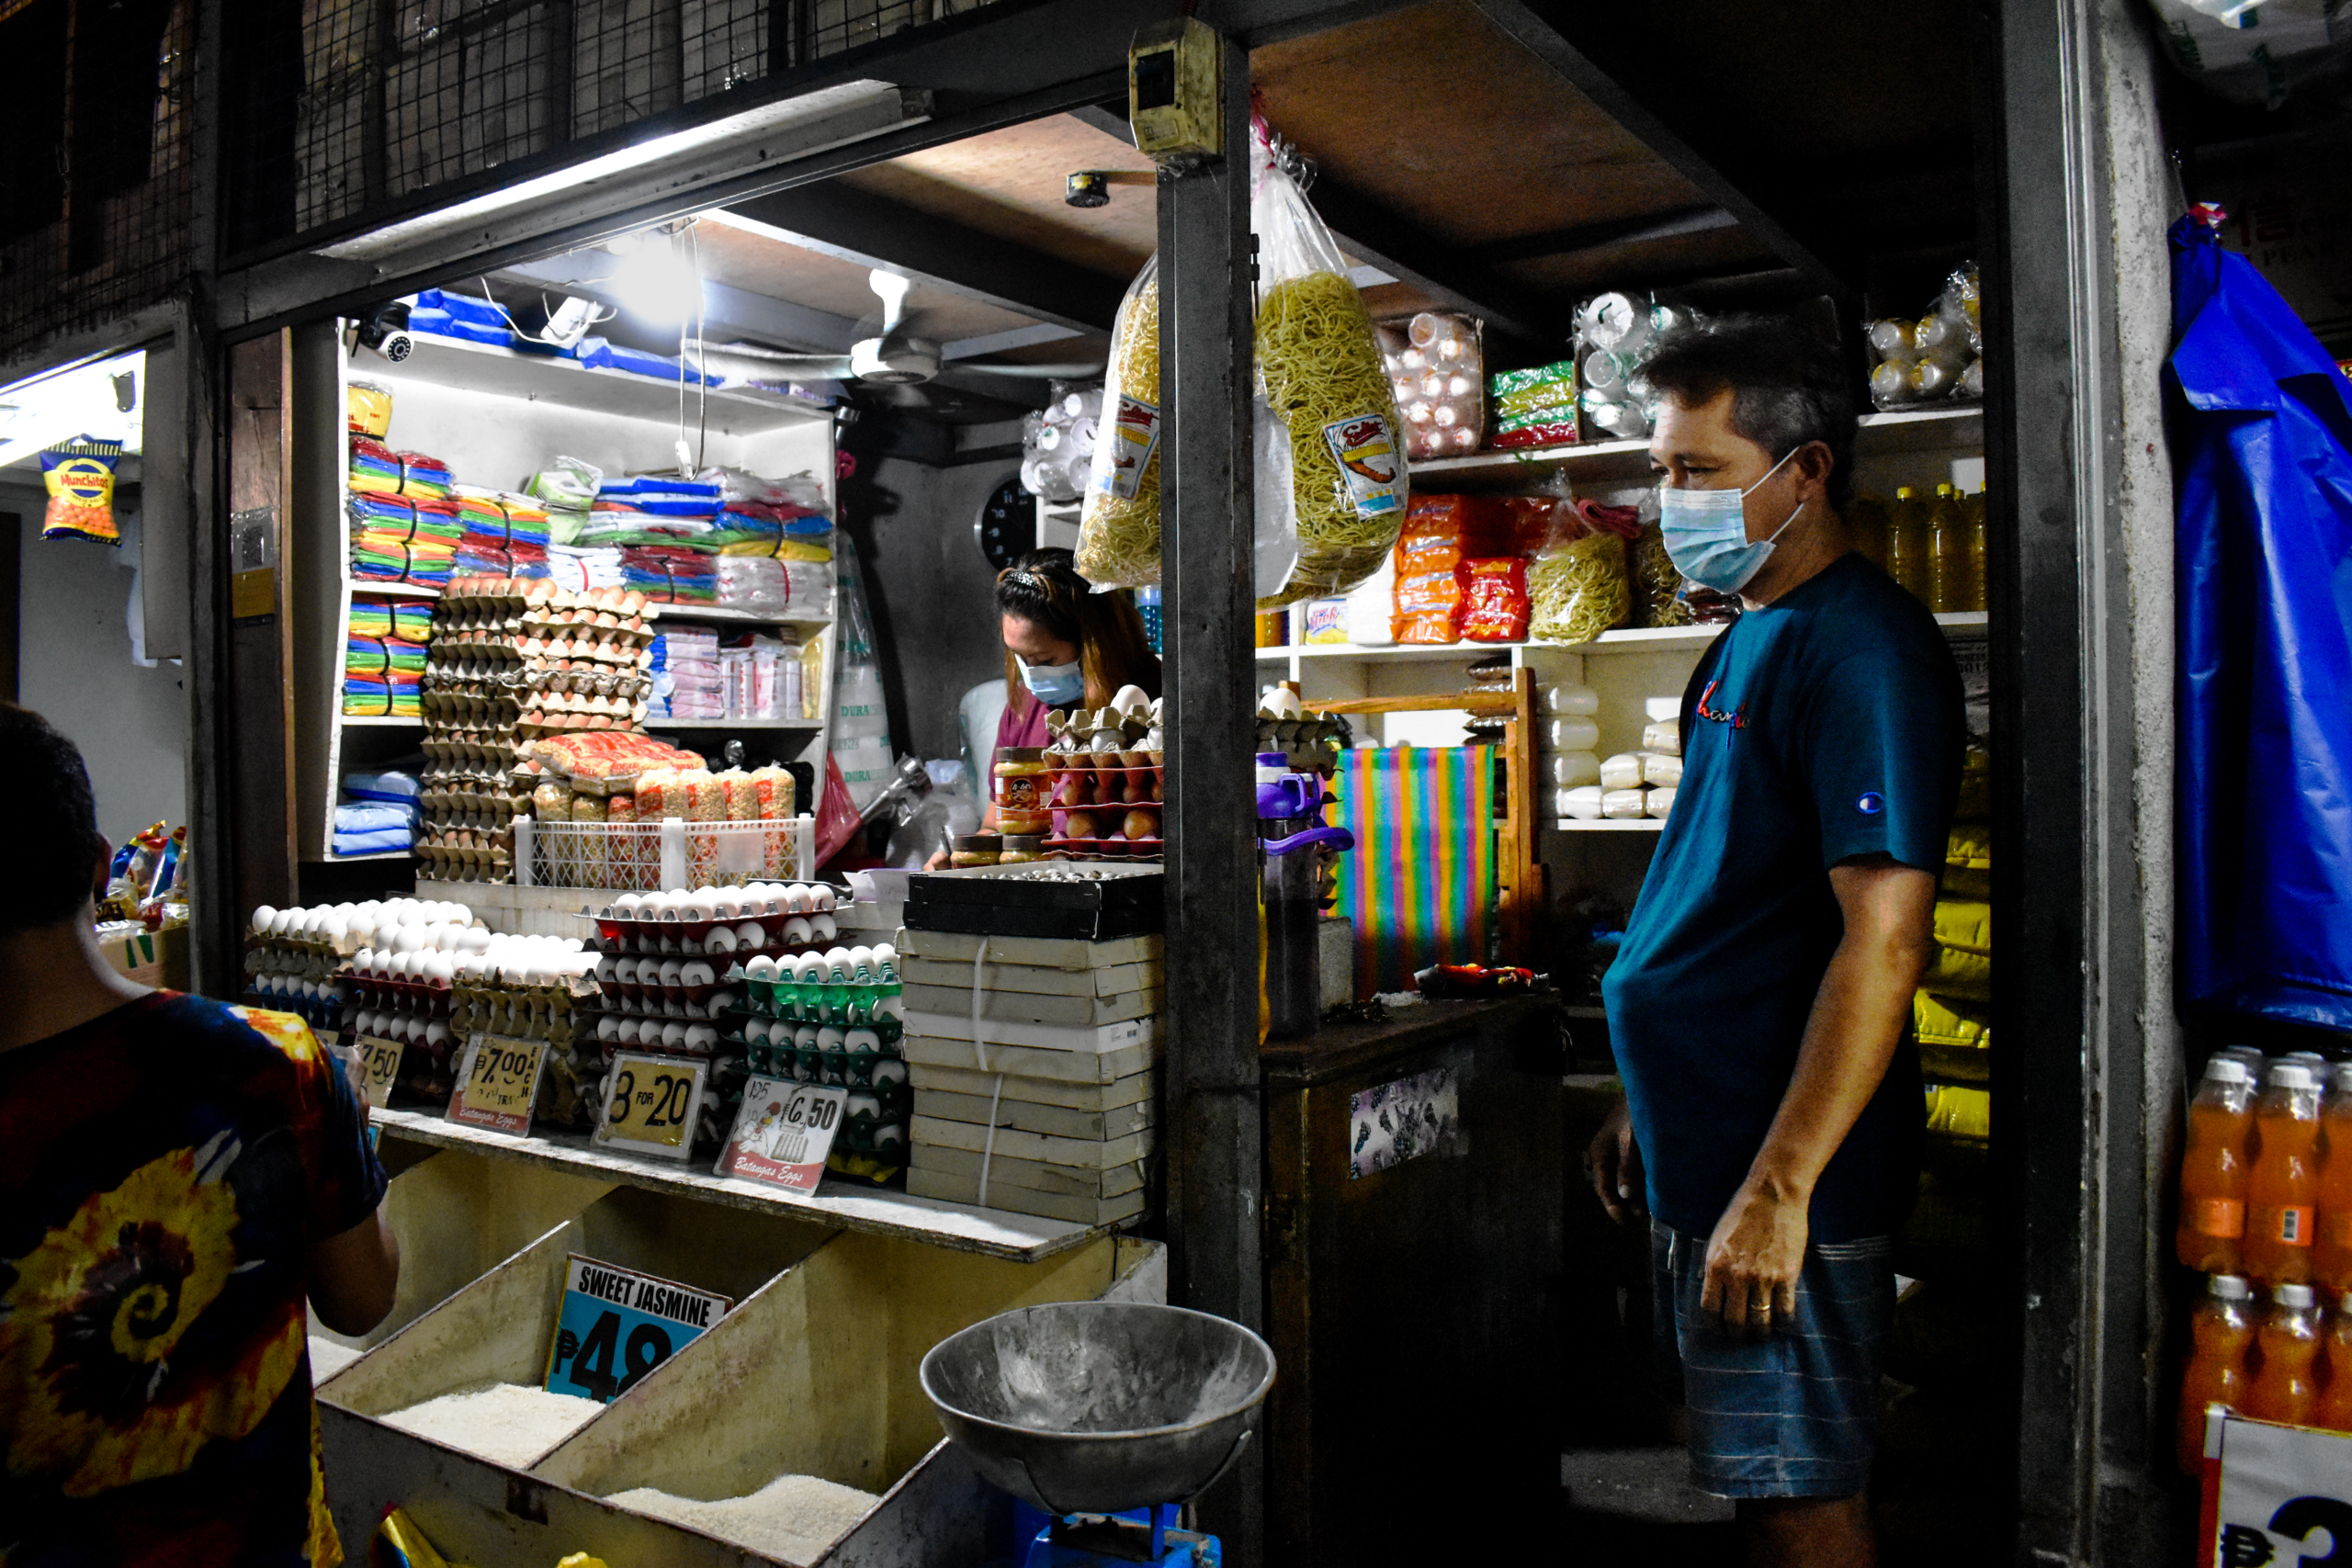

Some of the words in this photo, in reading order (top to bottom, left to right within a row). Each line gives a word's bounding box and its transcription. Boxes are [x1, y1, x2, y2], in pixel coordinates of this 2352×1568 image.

[61, 473, 109, 489] Munchitos
[609, 1070, 635, 1123] 3
[636, 1091, 654, 1106] FOR
[645, 1074, 692, 1127] 20
[460, 1107, 494, 1123] Batangas
[496, 1111, 516, 1129] Eggs
[735, 1156, 776, 1178] Batangas
[777, 1166, 804, 1185] Eggs
[578, 1266, 636, 1305] SWEET
[634, 1282, 711, 1328] JASMINE
